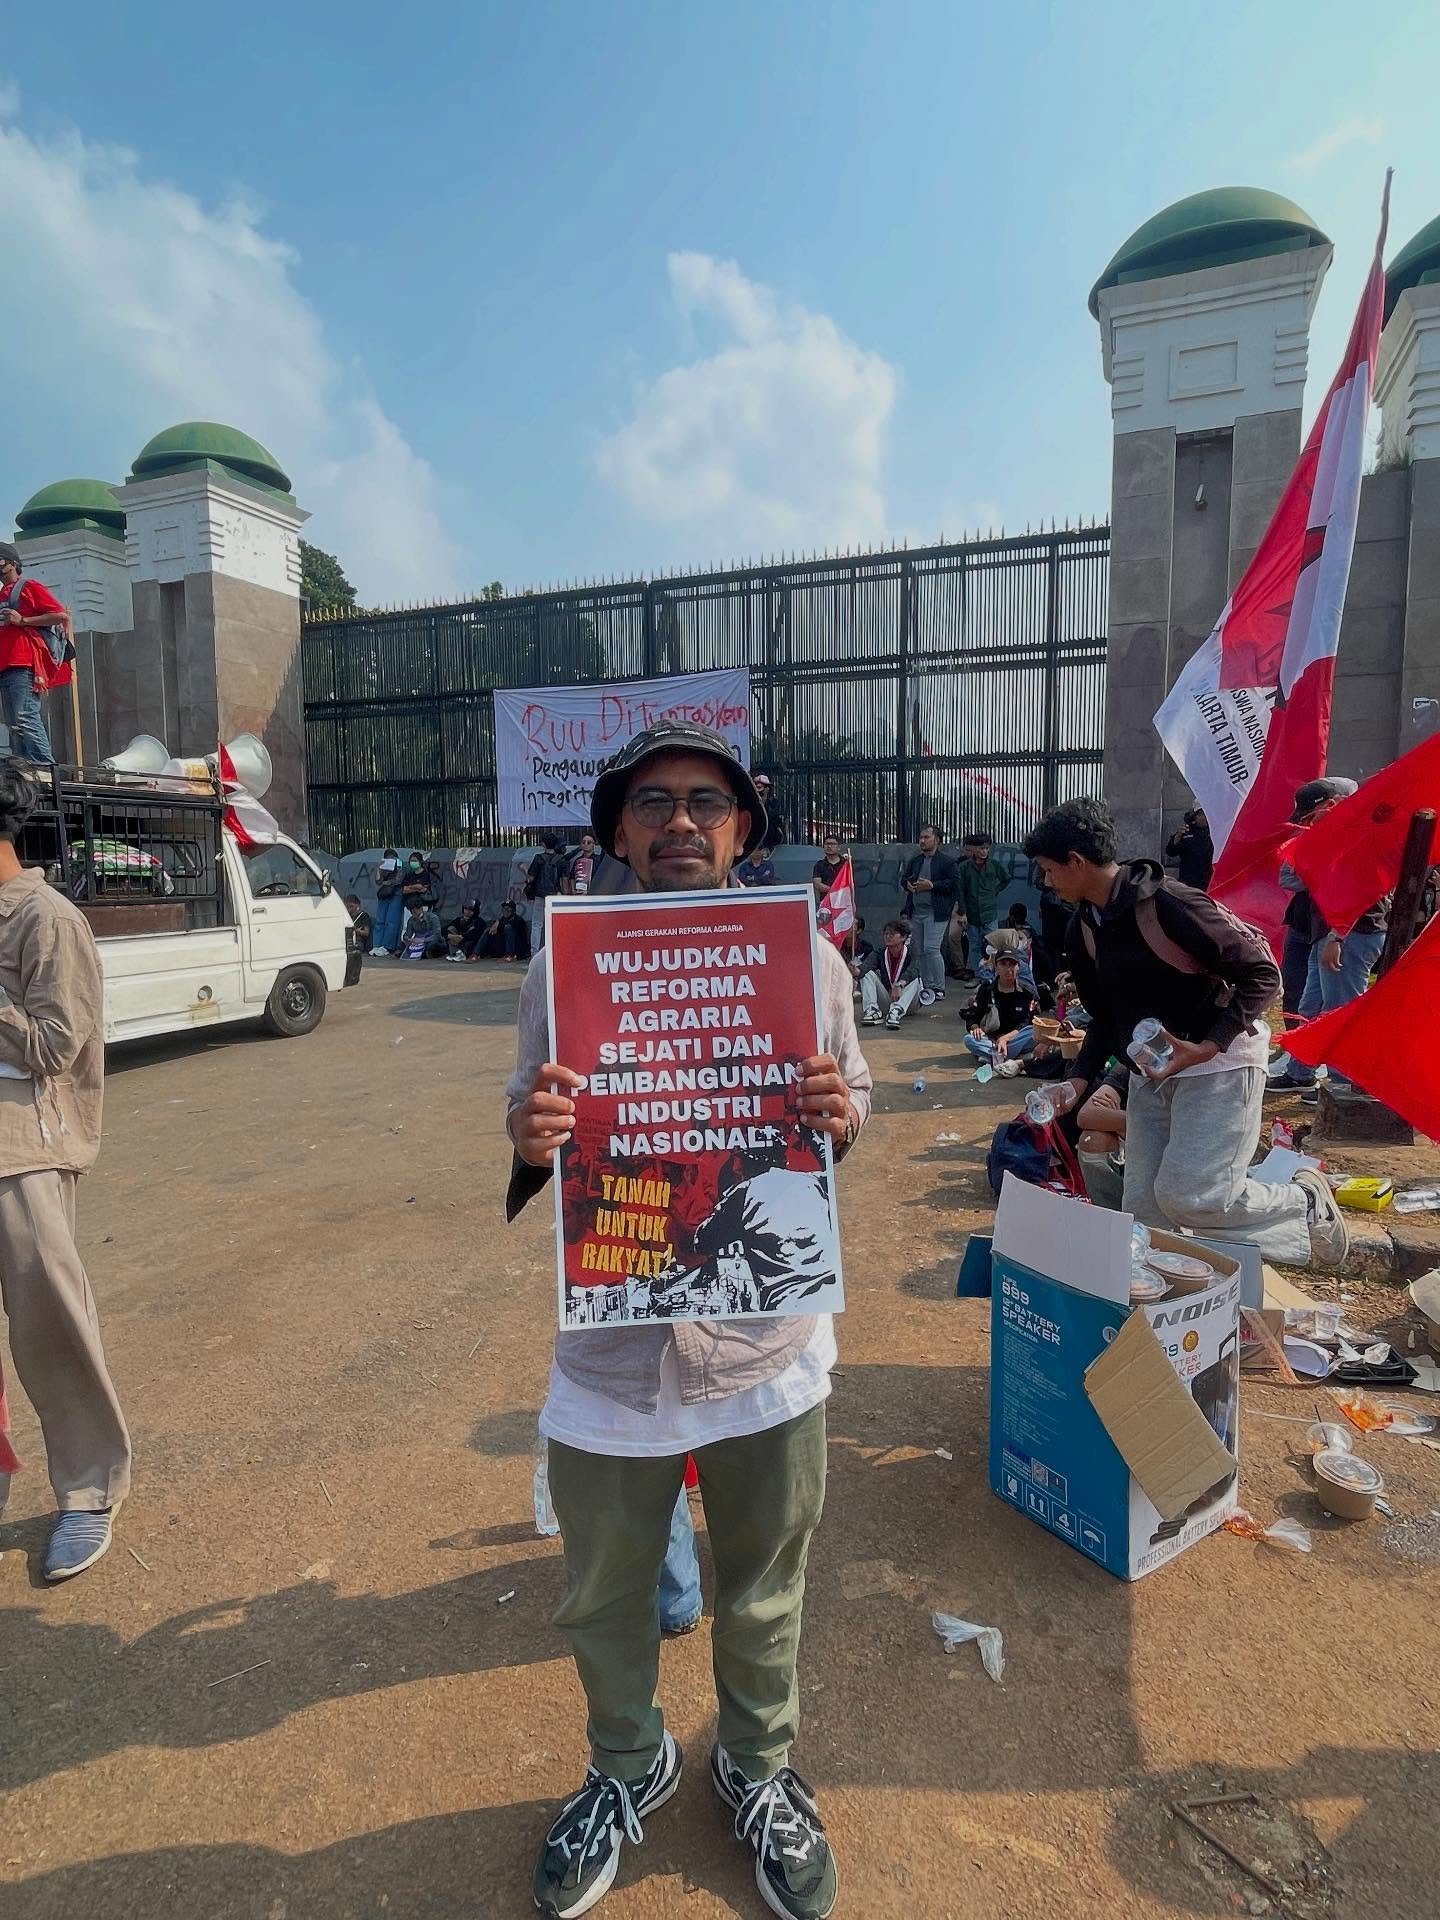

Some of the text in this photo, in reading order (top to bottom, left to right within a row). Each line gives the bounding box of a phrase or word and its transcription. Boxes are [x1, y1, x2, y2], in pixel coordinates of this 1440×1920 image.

[1216, 732, 1249, 785] TIMUR
[616, 924, 744, 939] ALIANSI GERAKAN REFORMA AGRARIA
[595, 943, 767, 975] WUJUDKAN
[611, 974, 757, 1004] REFORMA
[617, 1005, 753, 1034] AGRARIA
[599, 1033, 773, 1065] SEJATI DAN
[570, 1062, 804, 1098] PEMBANGUNAN
[617, 1095, 762, 1126] INDUSTRI
[601, 1174, 671, 1208] TANAH
[595, 1207, 668, 1243] UNTUK
[1014, 1303, 1061, 1334] BATTERY
[1152, 1280, 1239, 1330] NOISE
[1002, 1305, 1061, 1346] SPEAKER
[1137, 1534, 1181, 1573] PROFESSIONAL
[1182, 1519, 1208, 1545] BATTERY
